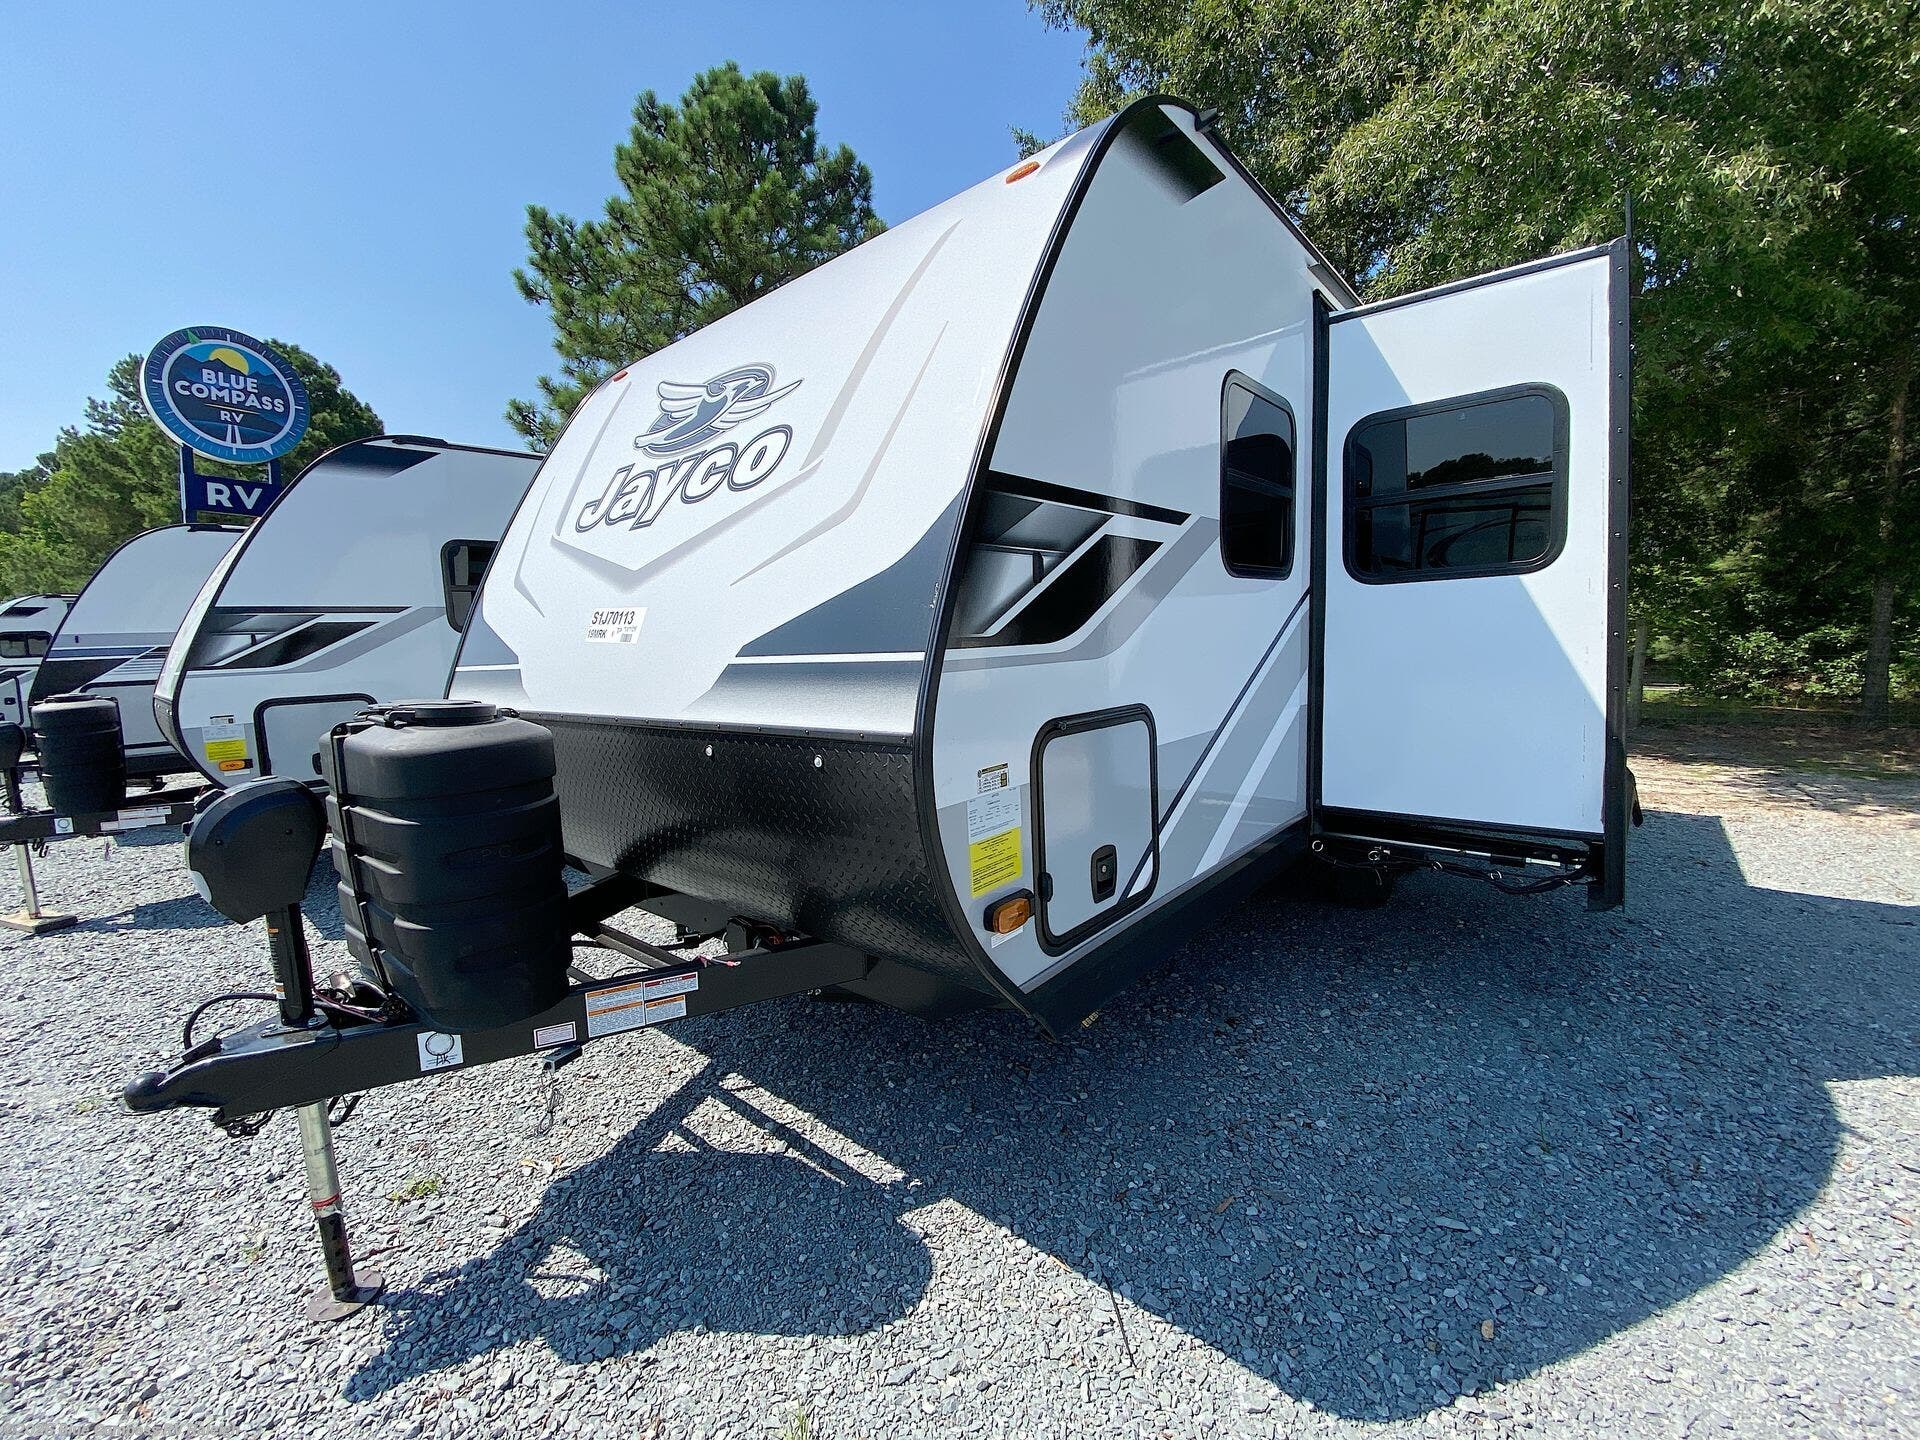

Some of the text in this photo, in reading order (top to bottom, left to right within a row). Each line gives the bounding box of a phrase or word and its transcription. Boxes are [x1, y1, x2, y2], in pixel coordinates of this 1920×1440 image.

[202, 368, 258, 393] BLUE
[174, 380, 285, 413] COMPASS
[220, 410, 243, 424] RV
[575, 424, 793, 533] Jayco
[206, 482, 262, 510] RV
[591, 610, 635, 625] S1J70113
